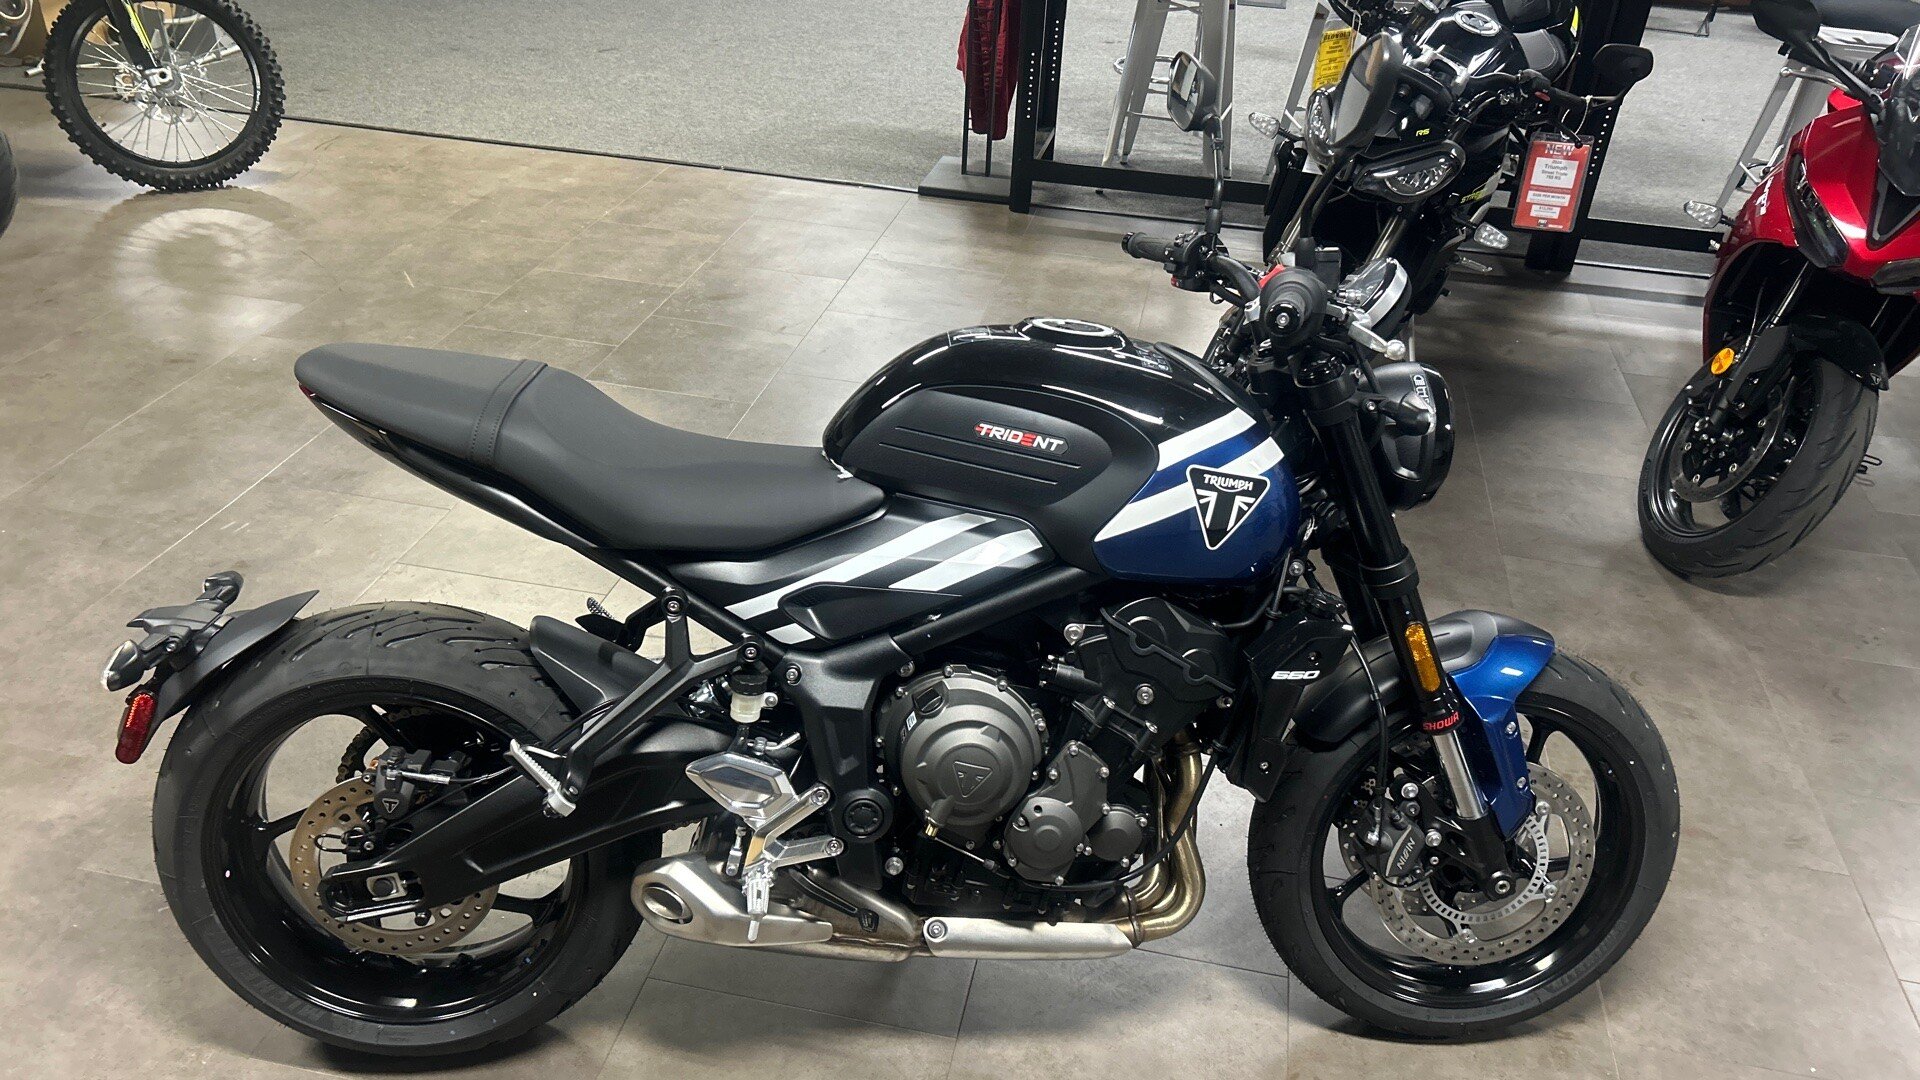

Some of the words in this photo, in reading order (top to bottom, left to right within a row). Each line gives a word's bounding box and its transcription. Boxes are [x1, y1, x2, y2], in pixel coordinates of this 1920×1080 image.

[1416, 128, 1430, 137] RS
[1545, 143, 1576, 156] NEW
[976, 423, 1064, 452] TRIDENT
[1203, 473, 1254, 492] TRIUMPH
[1271, 670, 1321, 680] 660
[1422, 711, 1459, 730] SHOWA
